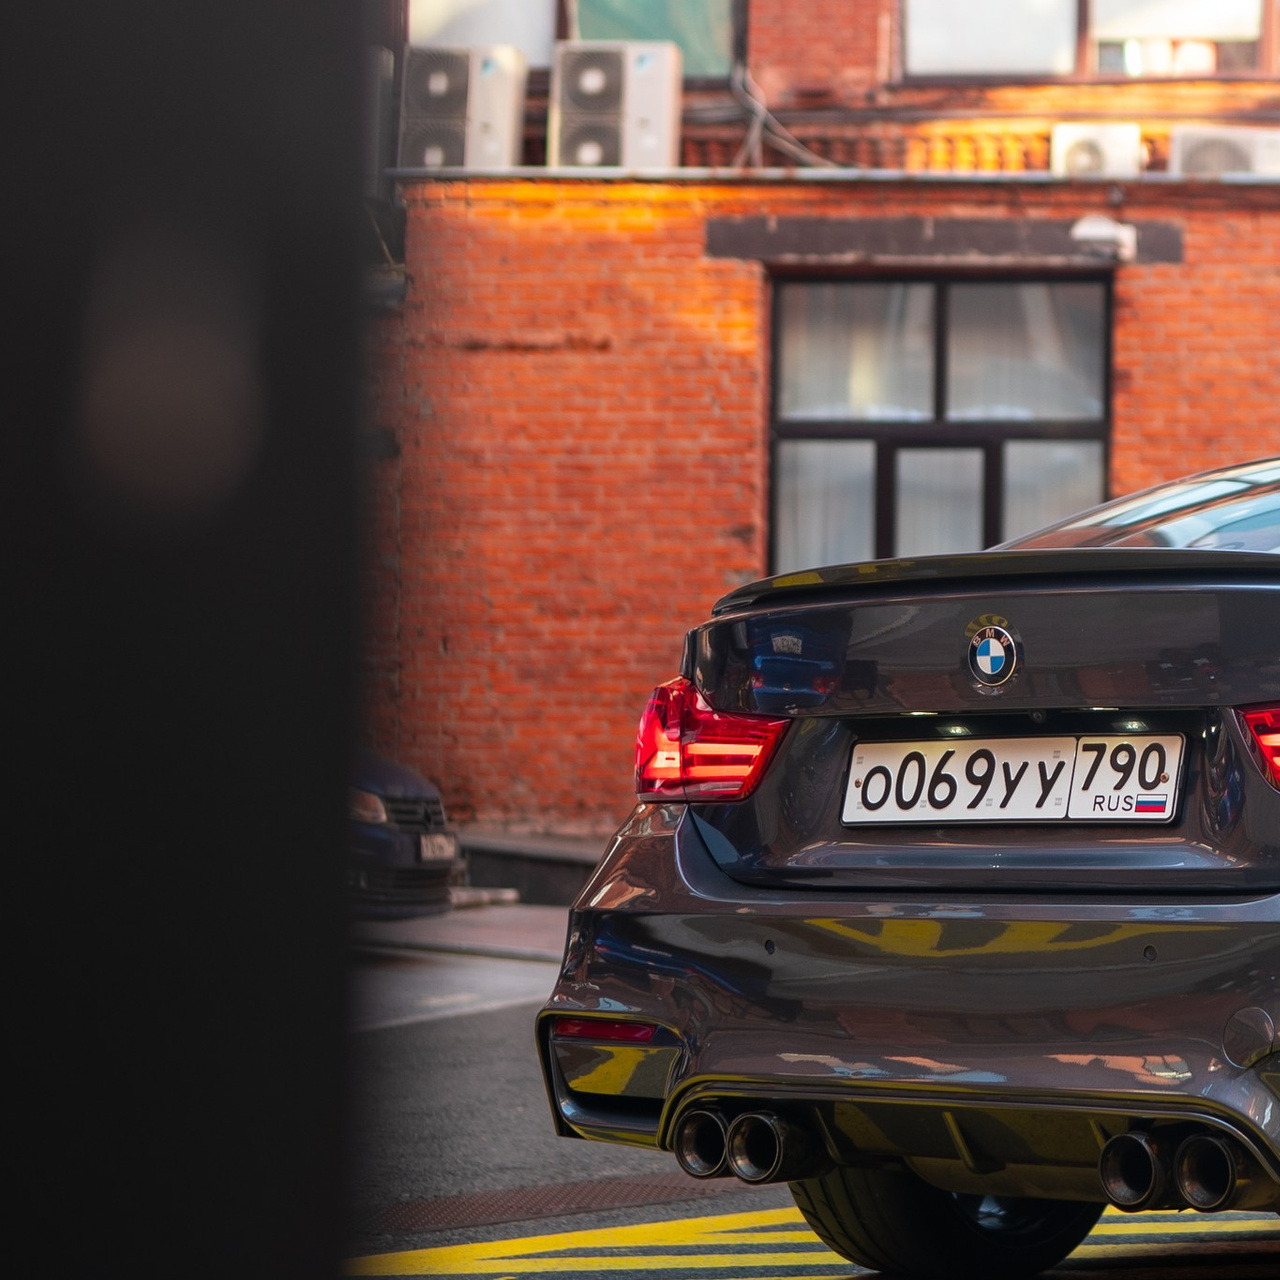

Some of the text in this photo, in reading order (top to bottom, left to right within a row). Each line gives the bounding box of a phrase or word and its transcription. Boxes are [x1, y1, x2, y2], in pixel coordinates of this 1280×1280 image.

[972, 628, 1010, 647] BMW
[1082, 742, 1167, 791] 790
[1093, 795, 1133, 811] RUS
